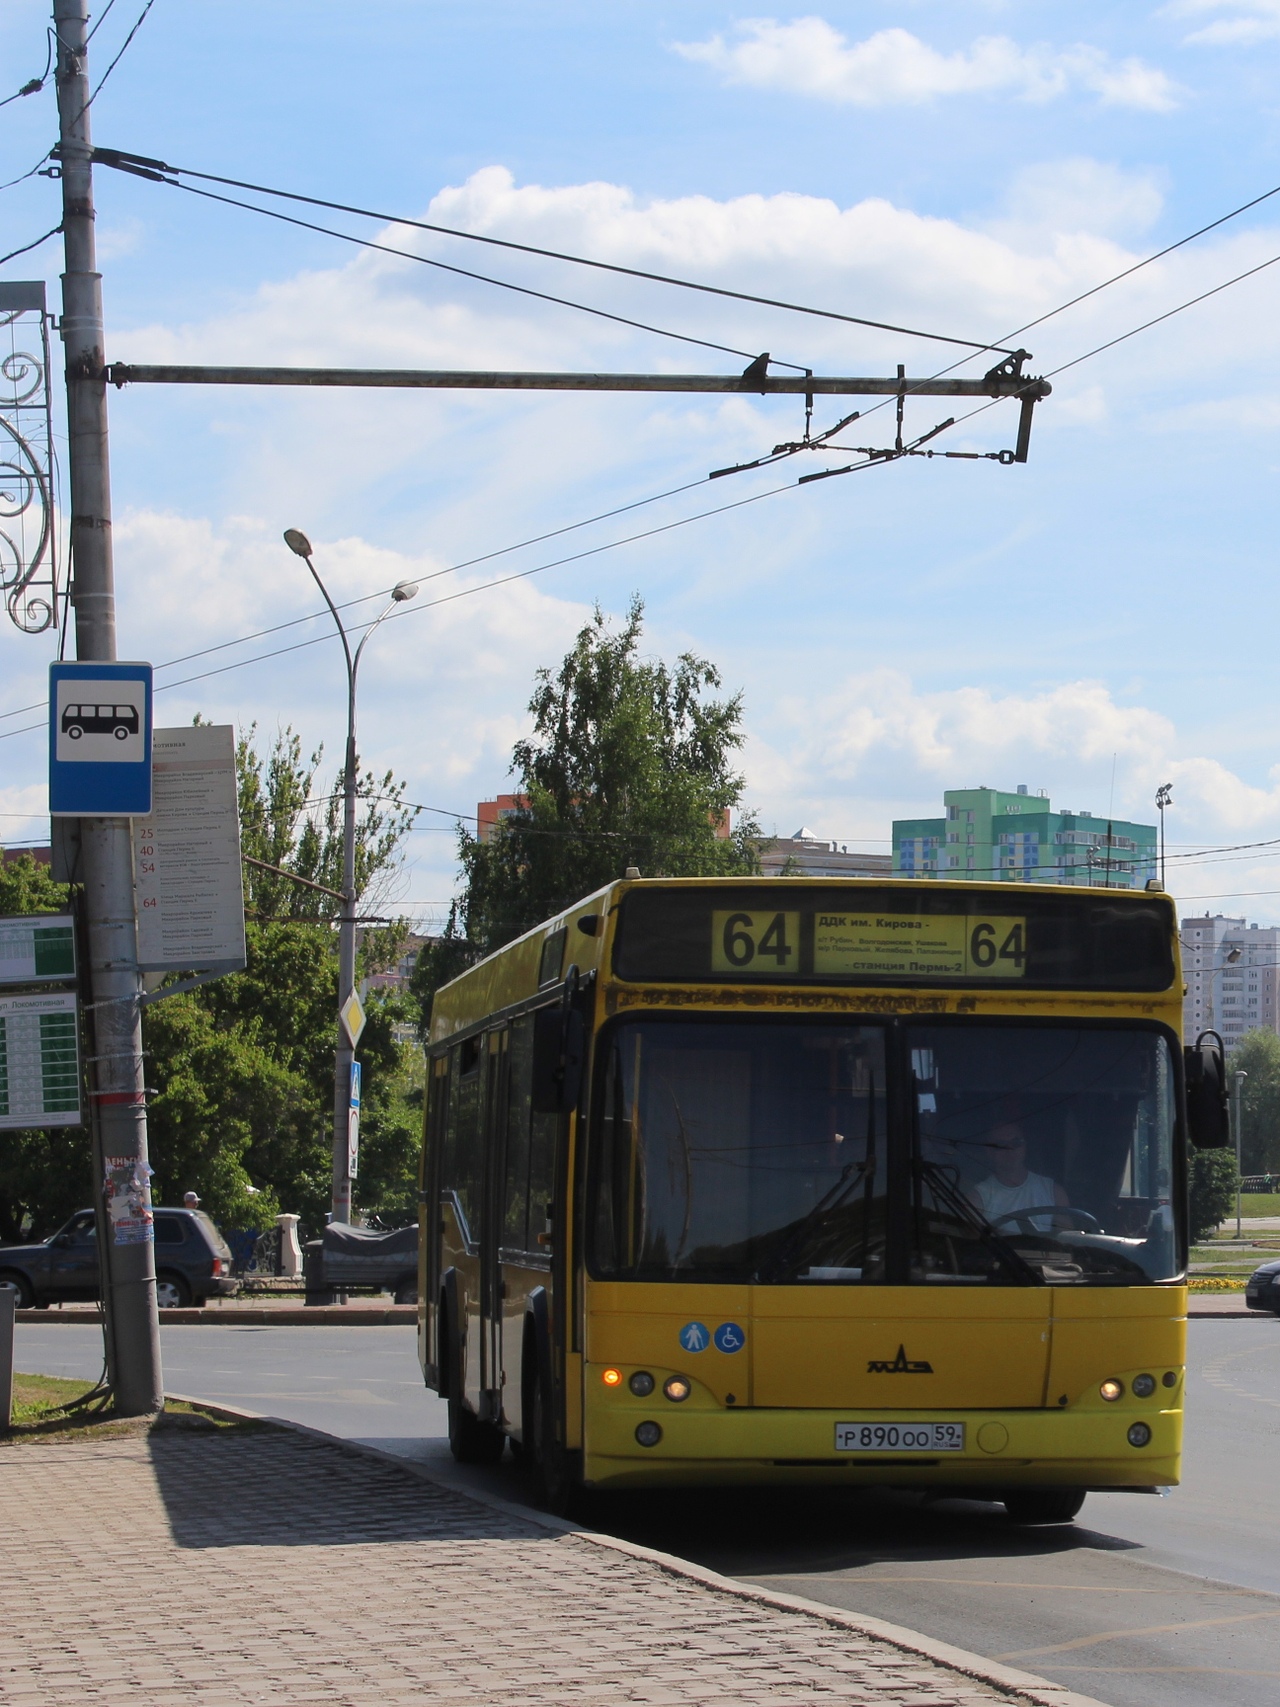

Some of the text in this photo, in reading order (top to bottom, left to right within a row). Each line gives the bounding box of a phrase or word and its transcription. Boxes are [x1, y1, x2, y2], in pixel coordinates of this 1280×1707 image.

[140, 828, 154, 839] 25
[140, 846, 154, 856] 40
[142, 863, 155, 873] 54
[143, 898, 156, 908] 64
[819, 916, 847, 928] ДДК
[851, 919, 872, 928] им.
[876, 918, 922, 930] Кирова
[723, 913, 792, 967] 64
[971, 922, 1026, 968] 64
[853, 961, 905, 972] станция
[910, 962, 962, 974] Пермь-2
[12, 1000, 64, 1008] Локомотивная
[935, 1426, 956, 1442] 59
